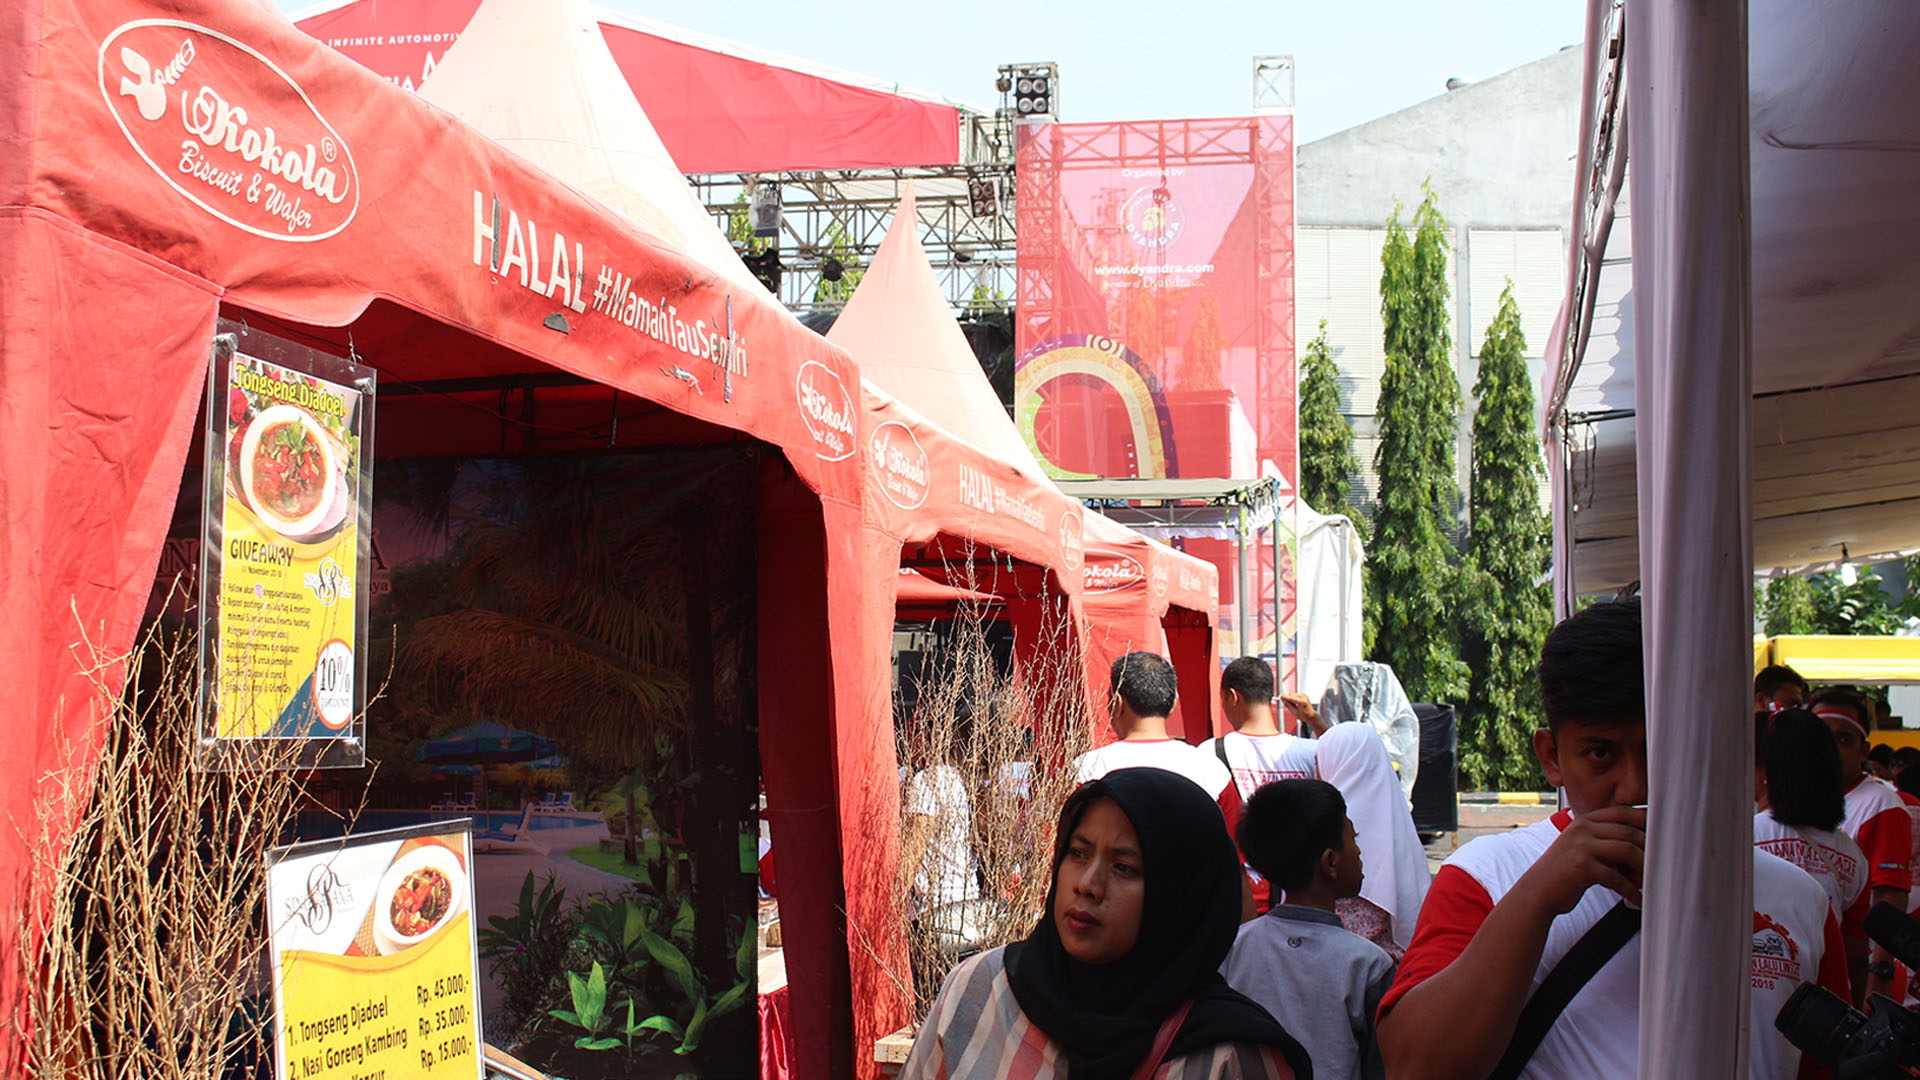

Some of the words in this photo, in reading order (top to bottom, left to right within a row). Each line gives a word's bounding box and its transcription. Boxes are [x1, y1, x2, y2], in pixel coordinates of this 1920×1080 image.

[328, 36, 384, 47] INFINITE
[182, 86, 350, 204] Kokola
[178, 140, 243, 197] Biscuit
[246, 173, 263, 204] &
[264, 183, 313, 233] Wafer
[473, 189, 588, 315] HALAL
[1094, 264, 1215, 276] www.dyandra.com
[236, 364, 298, 402] Tongseng
[300, 385, 344, 416] Djadoel
[888, 446, 927, 487] Kokola
[959, 463, 995, 514] HALAL
[230, 538, 295, 567] GIVEAWAY
[1083, 563, 1138, 578] okola
[319, 655, 351, 694] 10%
[1751, 978, 1775, 990] 2018
[288, 1025, 298, 1046] 1.
[299, 1012, 349, 1043] Tongseng
[350, 995, 389, 1030] Djadoel
[417, 985, 432, 1009] Rp.
[434, 973, 470, 999] 45.000,-
[289, 1060, 300, 1080] 2.
[302, 1052, 324, 1080] Nasi
[325, 1040, 364, 1070] Goreng
[364, 1025, 408, 1056] Kambing
[418, 1017, 433, 1041] Rp.
[435, 1004, 471, 1031] 35.000,-
[420, 1049, 436, 1073] Rp.
[438, 1035, 473, 1062] 15.000,-
